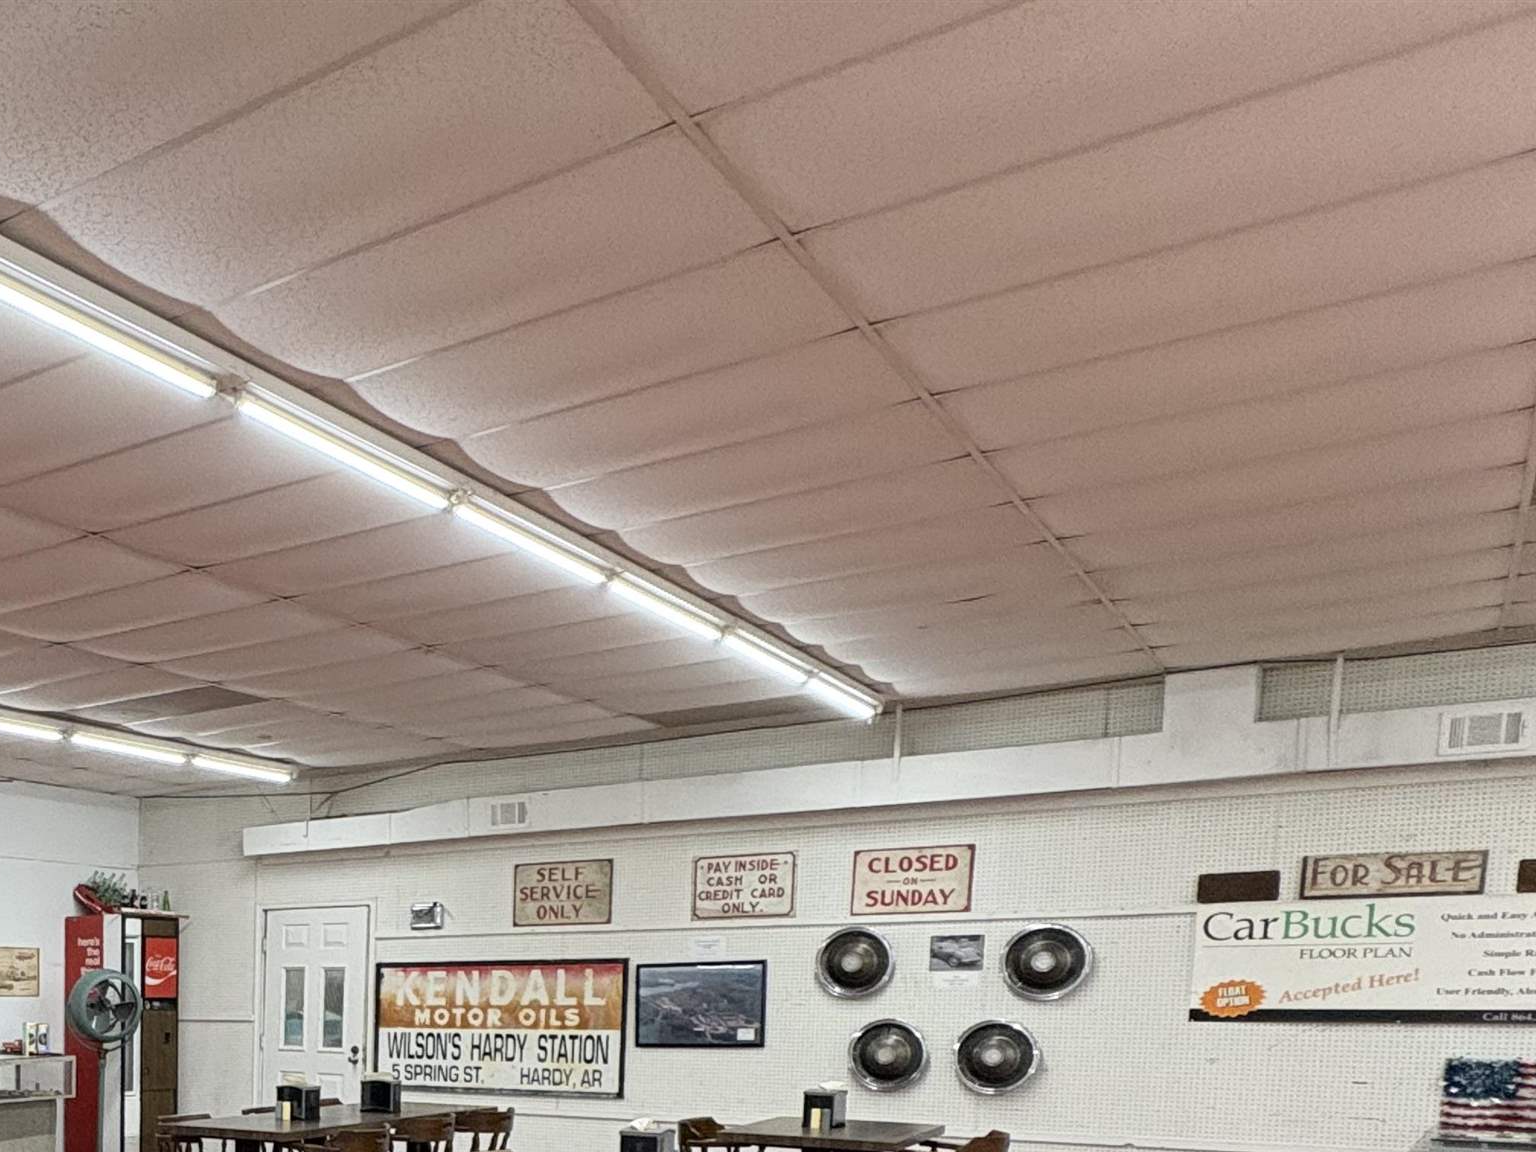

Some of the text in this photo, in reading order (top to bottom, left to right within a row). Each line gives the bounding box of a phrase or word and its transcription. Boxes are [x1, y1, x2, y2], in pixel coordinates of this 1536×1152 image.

[707, 859, 780, 873] PAY INSIDE
[867, 854, 959, 873] CLOSED
[1311, 854, 1482, 887] FOR SALE
[536, 866, 586, 882] SELF
[706, 873, 777, 887] CASH OR
[902, 877, 918, 885] ON
[519, 884, 601, 901] SERVICE
[698, 887, 785, 901] CREDIT CARD
[865, 888, 956, 907] SUNDAY
[536, 903, 584, 920] ONLY
[721, 901, 764, 914] ONLY.
[1203, 902, 1415, 941] CarBucks
[1441, 913, 1473, 922] Quick
[1477, 912, 1498, 920] and
[1501, 912, 1527, 921] Easy
[1299, 946, 1414, 960] FLOOR PLAN
[1468, 968, 1495, 976] Cash
[1499, 968, 1526, 976] Flow
[394, 968, 607, 1007] KENDALL
[1279, 968, 1420, 1004] Accepted Here!
[414, 1007, 581, 1027] MOTOR OILS
[1482, 1012, 1508, 1021] Call
[388, 1032, 610, 1065] WILSON'S HARDY STATION
[404, 1064, 459, 1083] SPRING
[463, 1066, 485, 1084] ST.
[520, 1067, 576, 1089] HARDY,
[581, 1069, 603, 1088] AR
